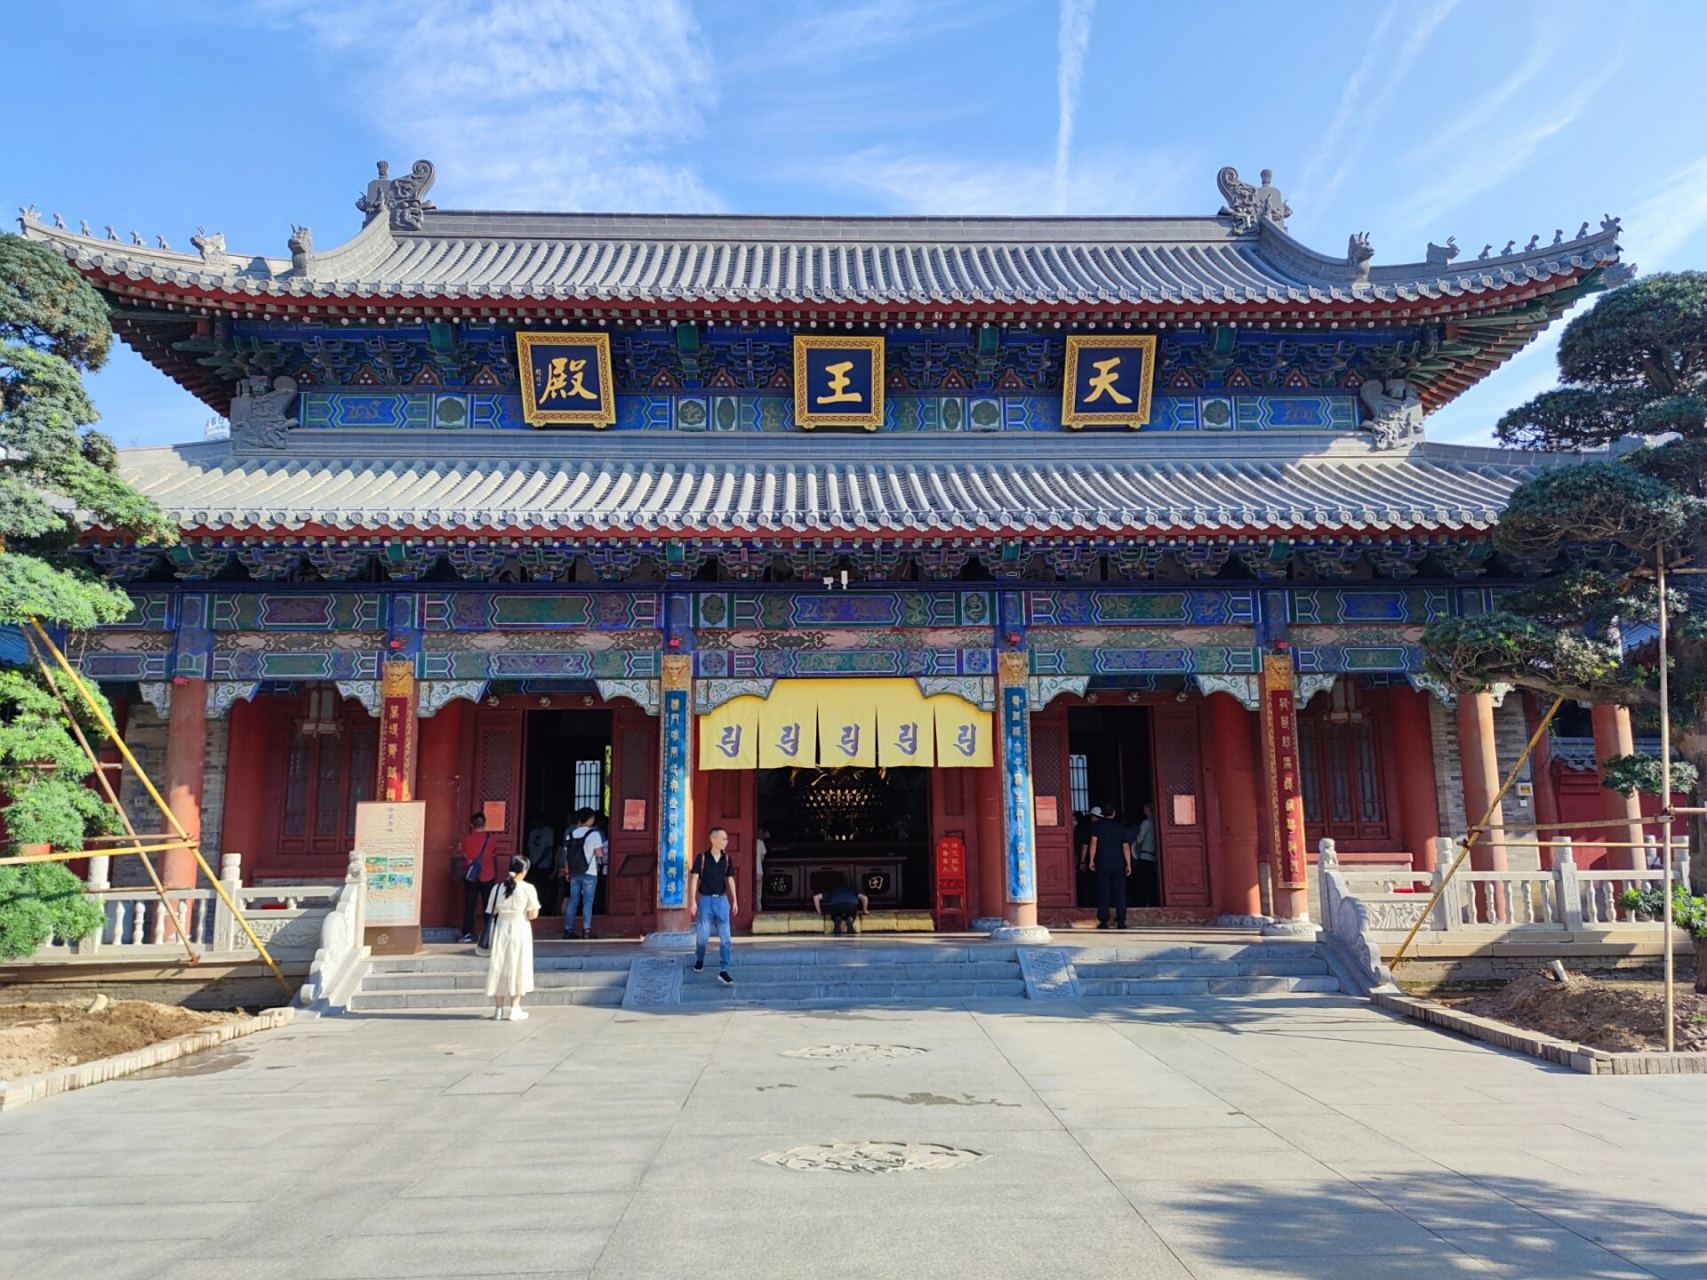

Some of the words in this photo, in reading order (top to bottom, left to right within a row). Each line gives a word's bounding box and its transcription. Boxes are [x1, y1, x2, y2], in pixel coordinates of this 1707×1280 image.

[539, 357, 598, 404] 殿
[817, 360, 863, 405] 王
[1083, 357, 1133, 404] 天
[868, 876, 884, 889] 田
